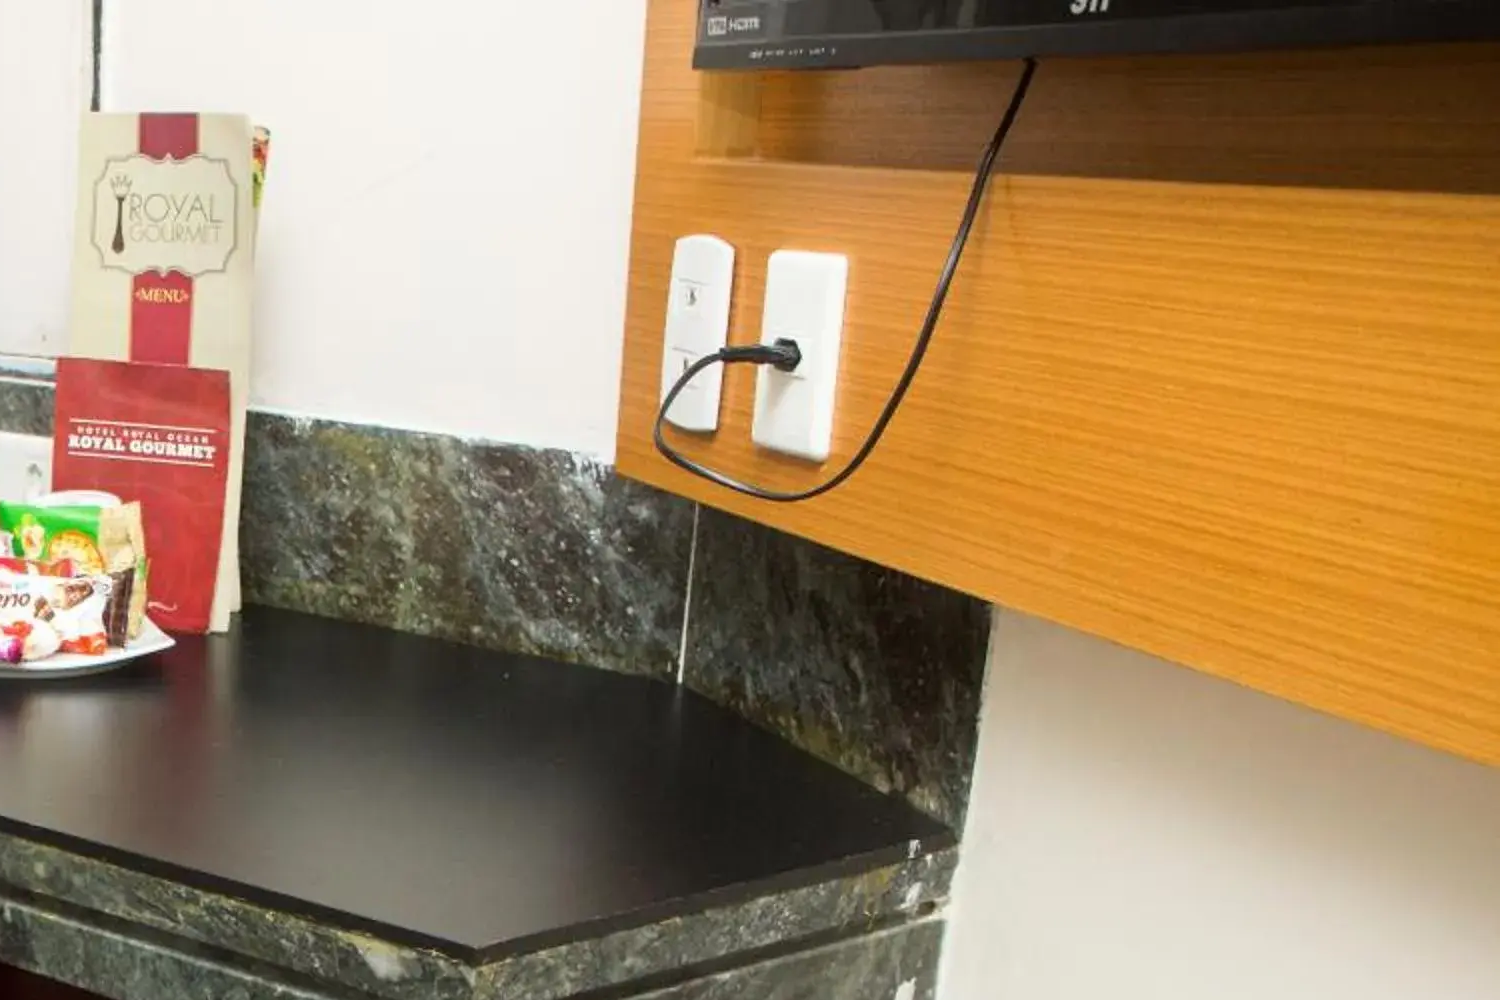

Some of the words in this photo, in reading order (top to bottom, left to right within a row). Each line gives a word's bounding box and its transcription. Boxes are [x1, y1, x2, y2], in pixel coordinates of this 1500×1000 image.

[128, 192, 224, 223] ROYAL
[128, 222, 223, 243] GOURMET
[138, 286, 186, 304] MENU
[67, 434, 126, 452] ROYAL
[128, 439, 217, 460] GOURMET
